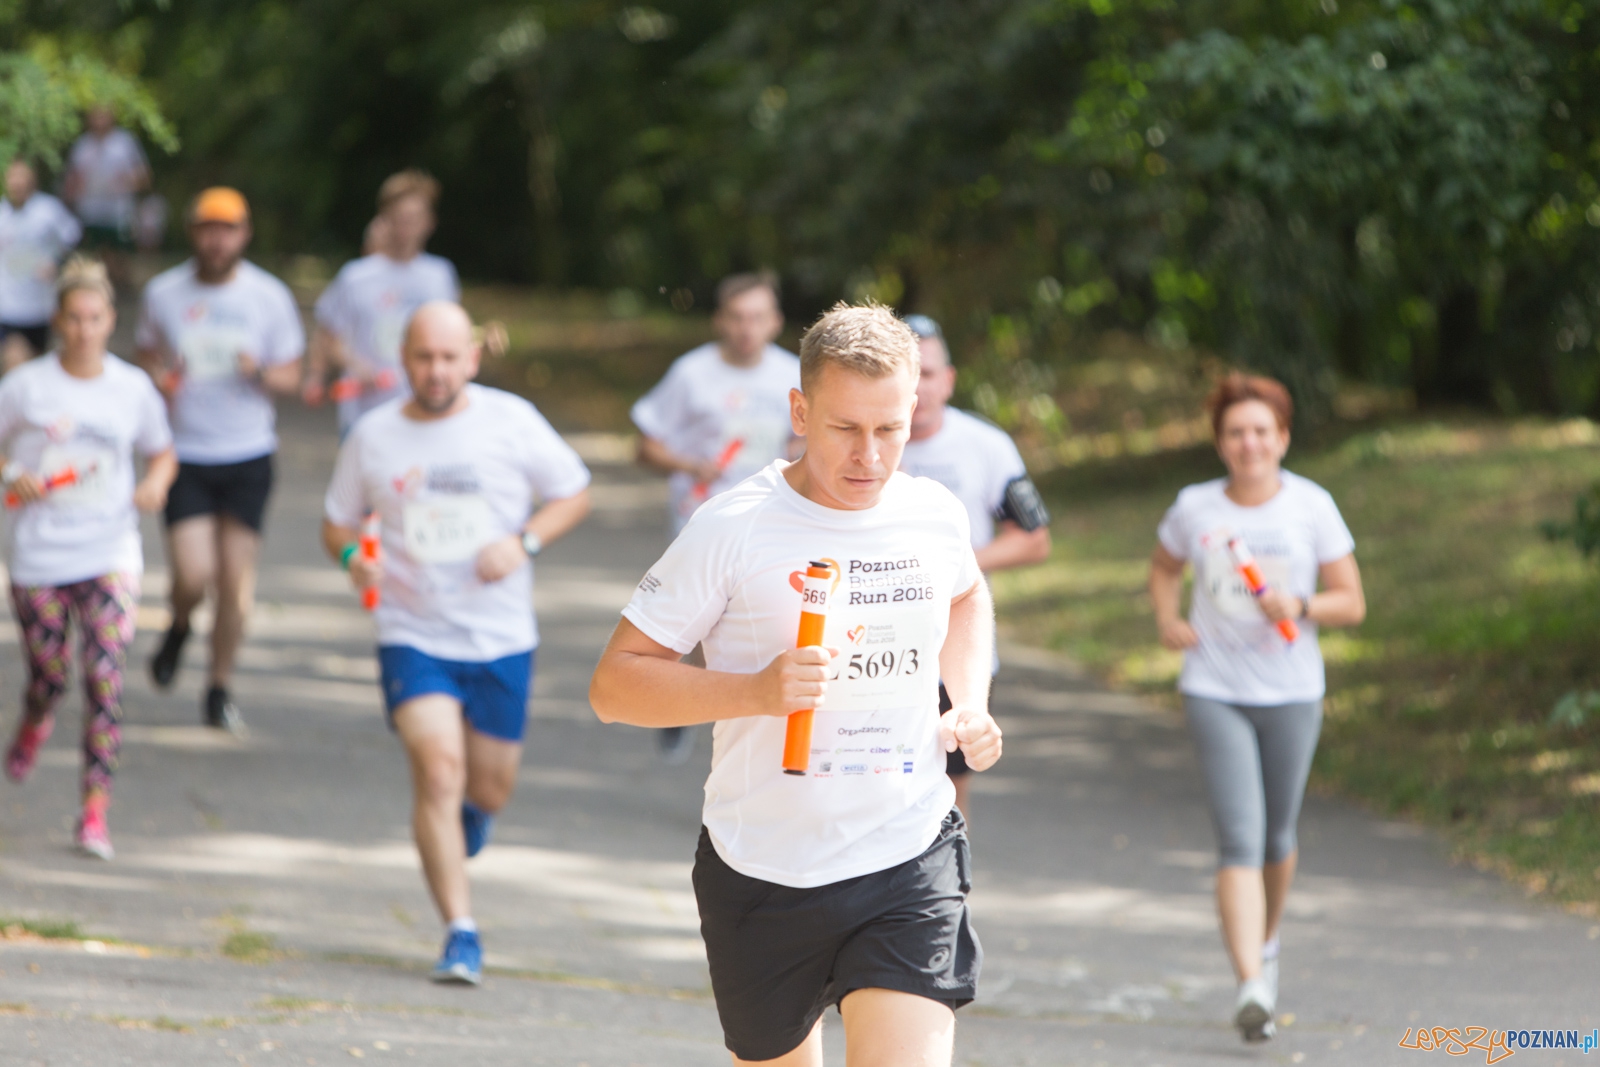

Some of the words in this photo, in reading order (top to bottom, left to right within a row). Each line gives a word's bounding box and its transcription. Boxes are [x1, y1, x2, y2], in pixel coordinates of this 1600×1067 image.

[849, 555, 920, 573] Poznań
[849, 573, 931, 589] Business
[803, 588, 827, 605] 569
[849, 591, 887, 605] Run
[893, 586, 934, 602] 2016
[848, 649, 919, 680] 569/3
[870, 746, 892, 754] ciber
